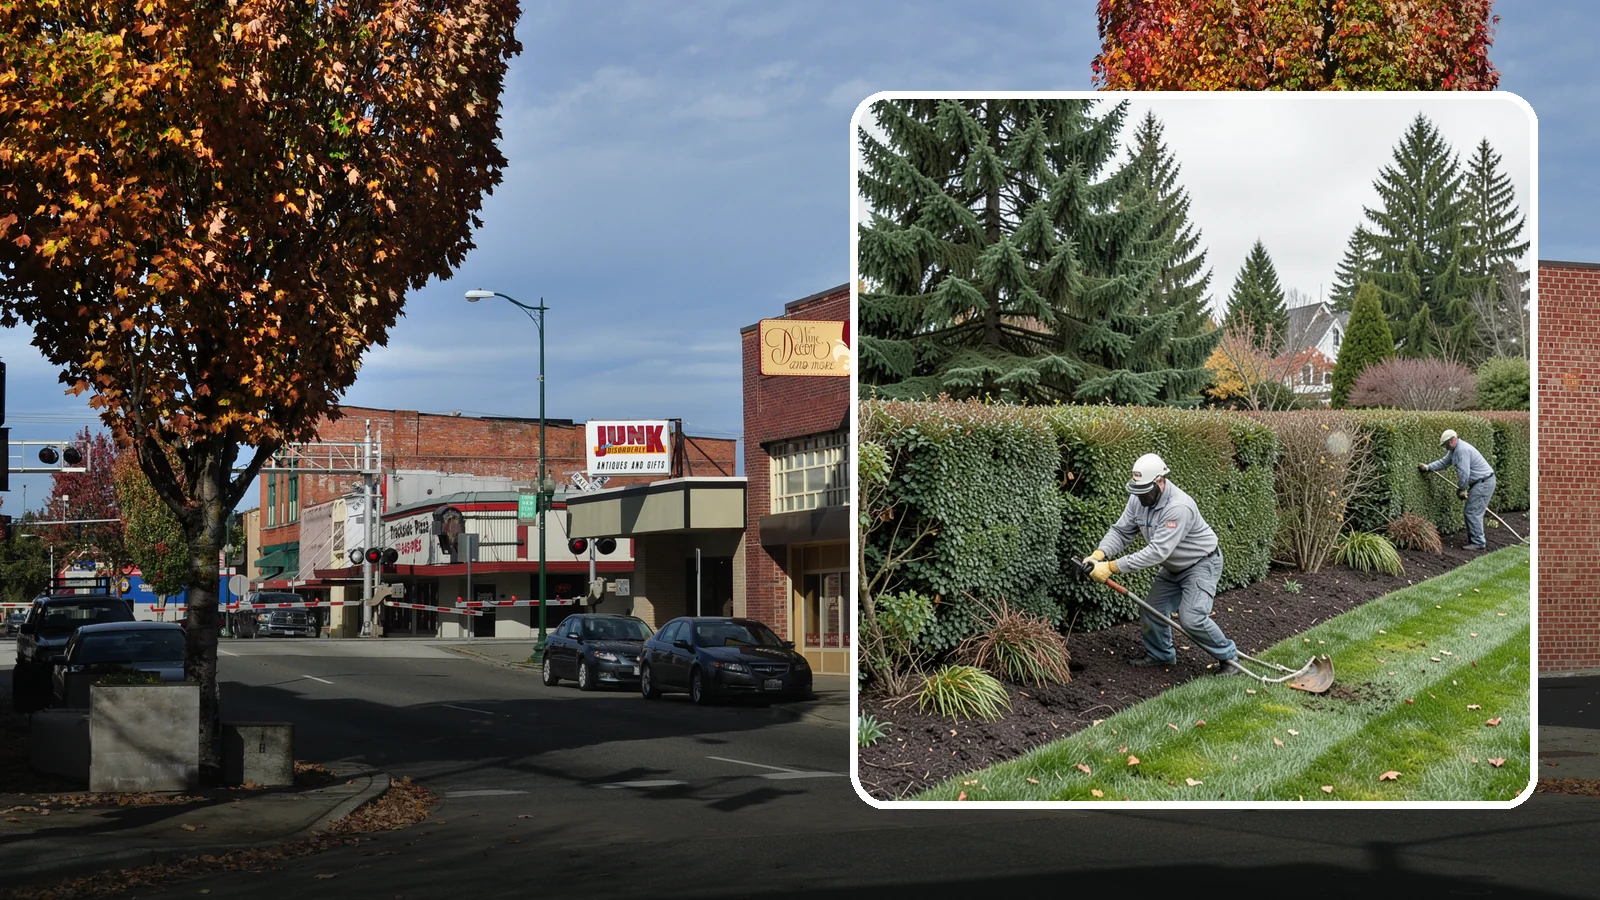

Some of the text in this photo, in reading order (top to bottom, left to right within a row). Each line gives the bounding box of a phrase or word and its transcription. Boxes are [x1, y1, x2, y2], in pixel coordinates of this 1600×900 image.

[765, 328, 830, 365] Decor
[595, 425, 665, 457] JUNK
[607, 446, 645, 454] DISORDERLY
[596, 460, 665, 470] ANTIQUES AND GIFTS
[352, 498, 365, 511] CRO
[414, 519, 429, 534] Pizza
